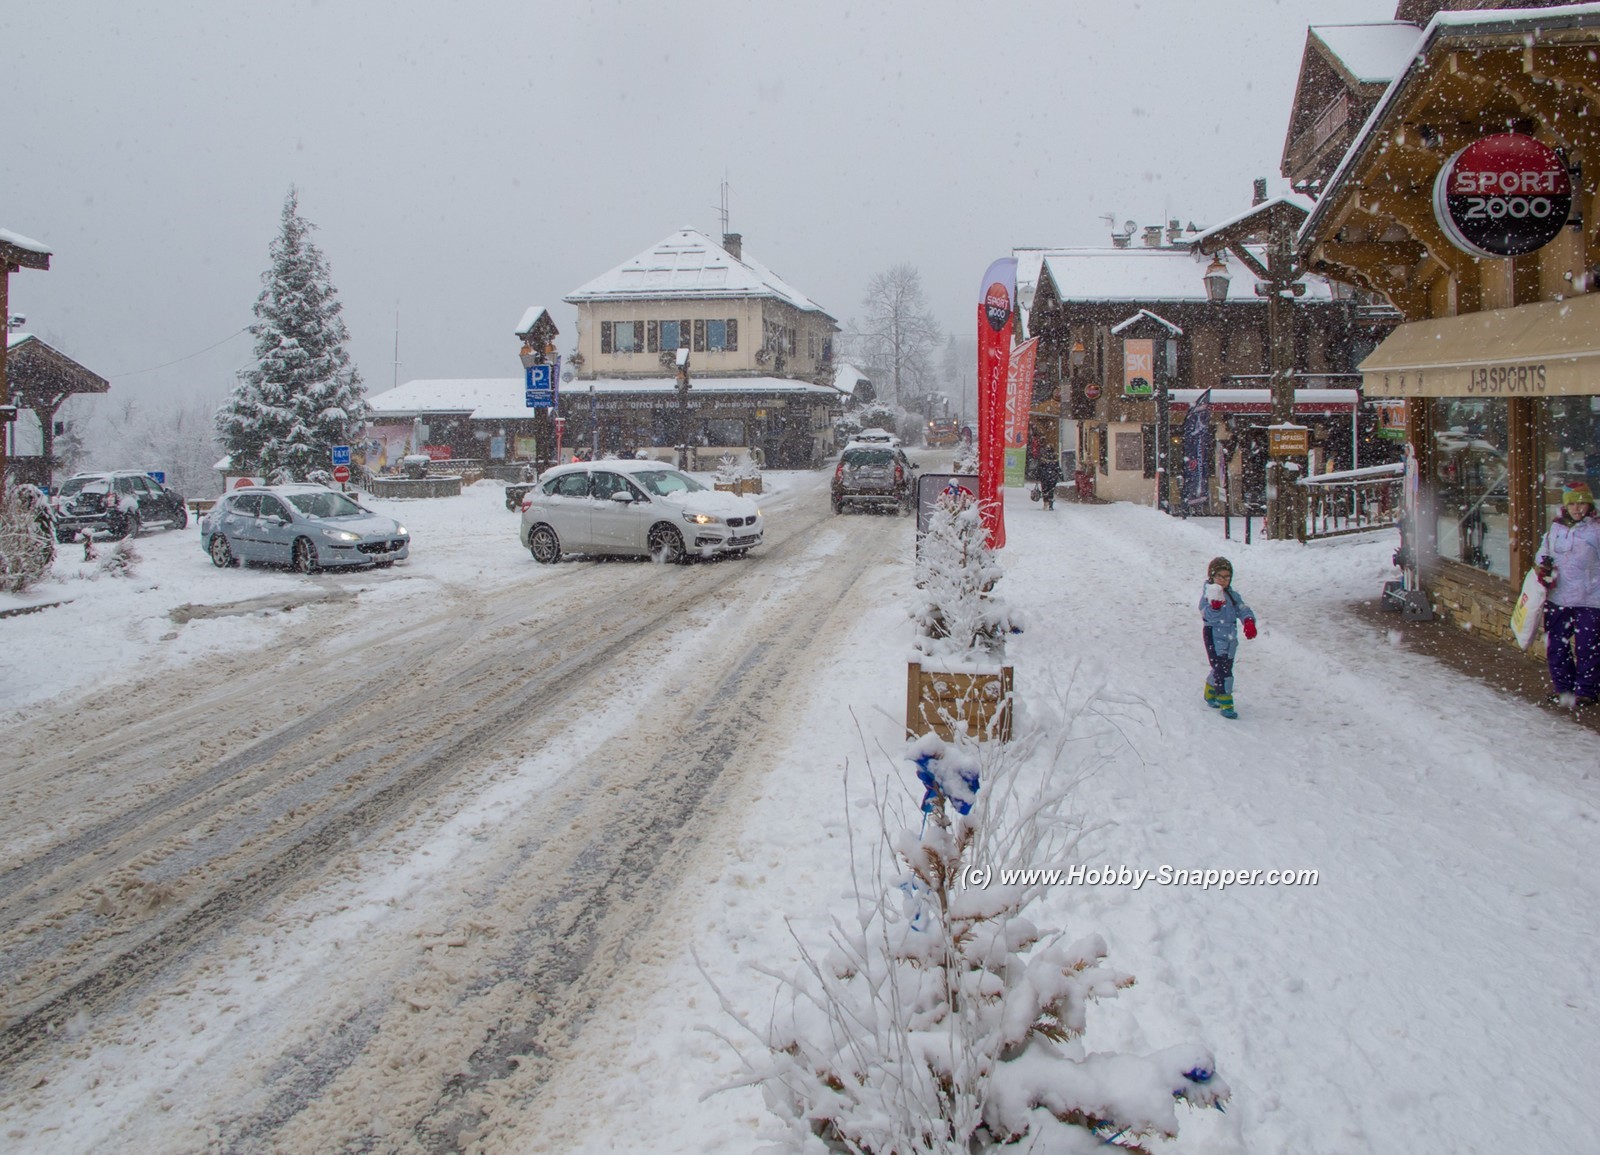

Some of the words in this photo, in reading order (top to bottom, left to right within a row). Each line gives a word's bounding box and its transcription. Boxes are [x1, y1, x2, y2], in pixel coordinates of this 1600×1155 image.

[1457, 171, 1560, 193] SPORT
[1467, 197, 1551, 218] 2000
[987, 295, 1008, 309] SPORT
[988, 306, 1006, 319] 2000
[1127, 353, 1151, 371] SKI
[532, 367, 544, 386] P
[334, 450, 349, 458] TAXI
